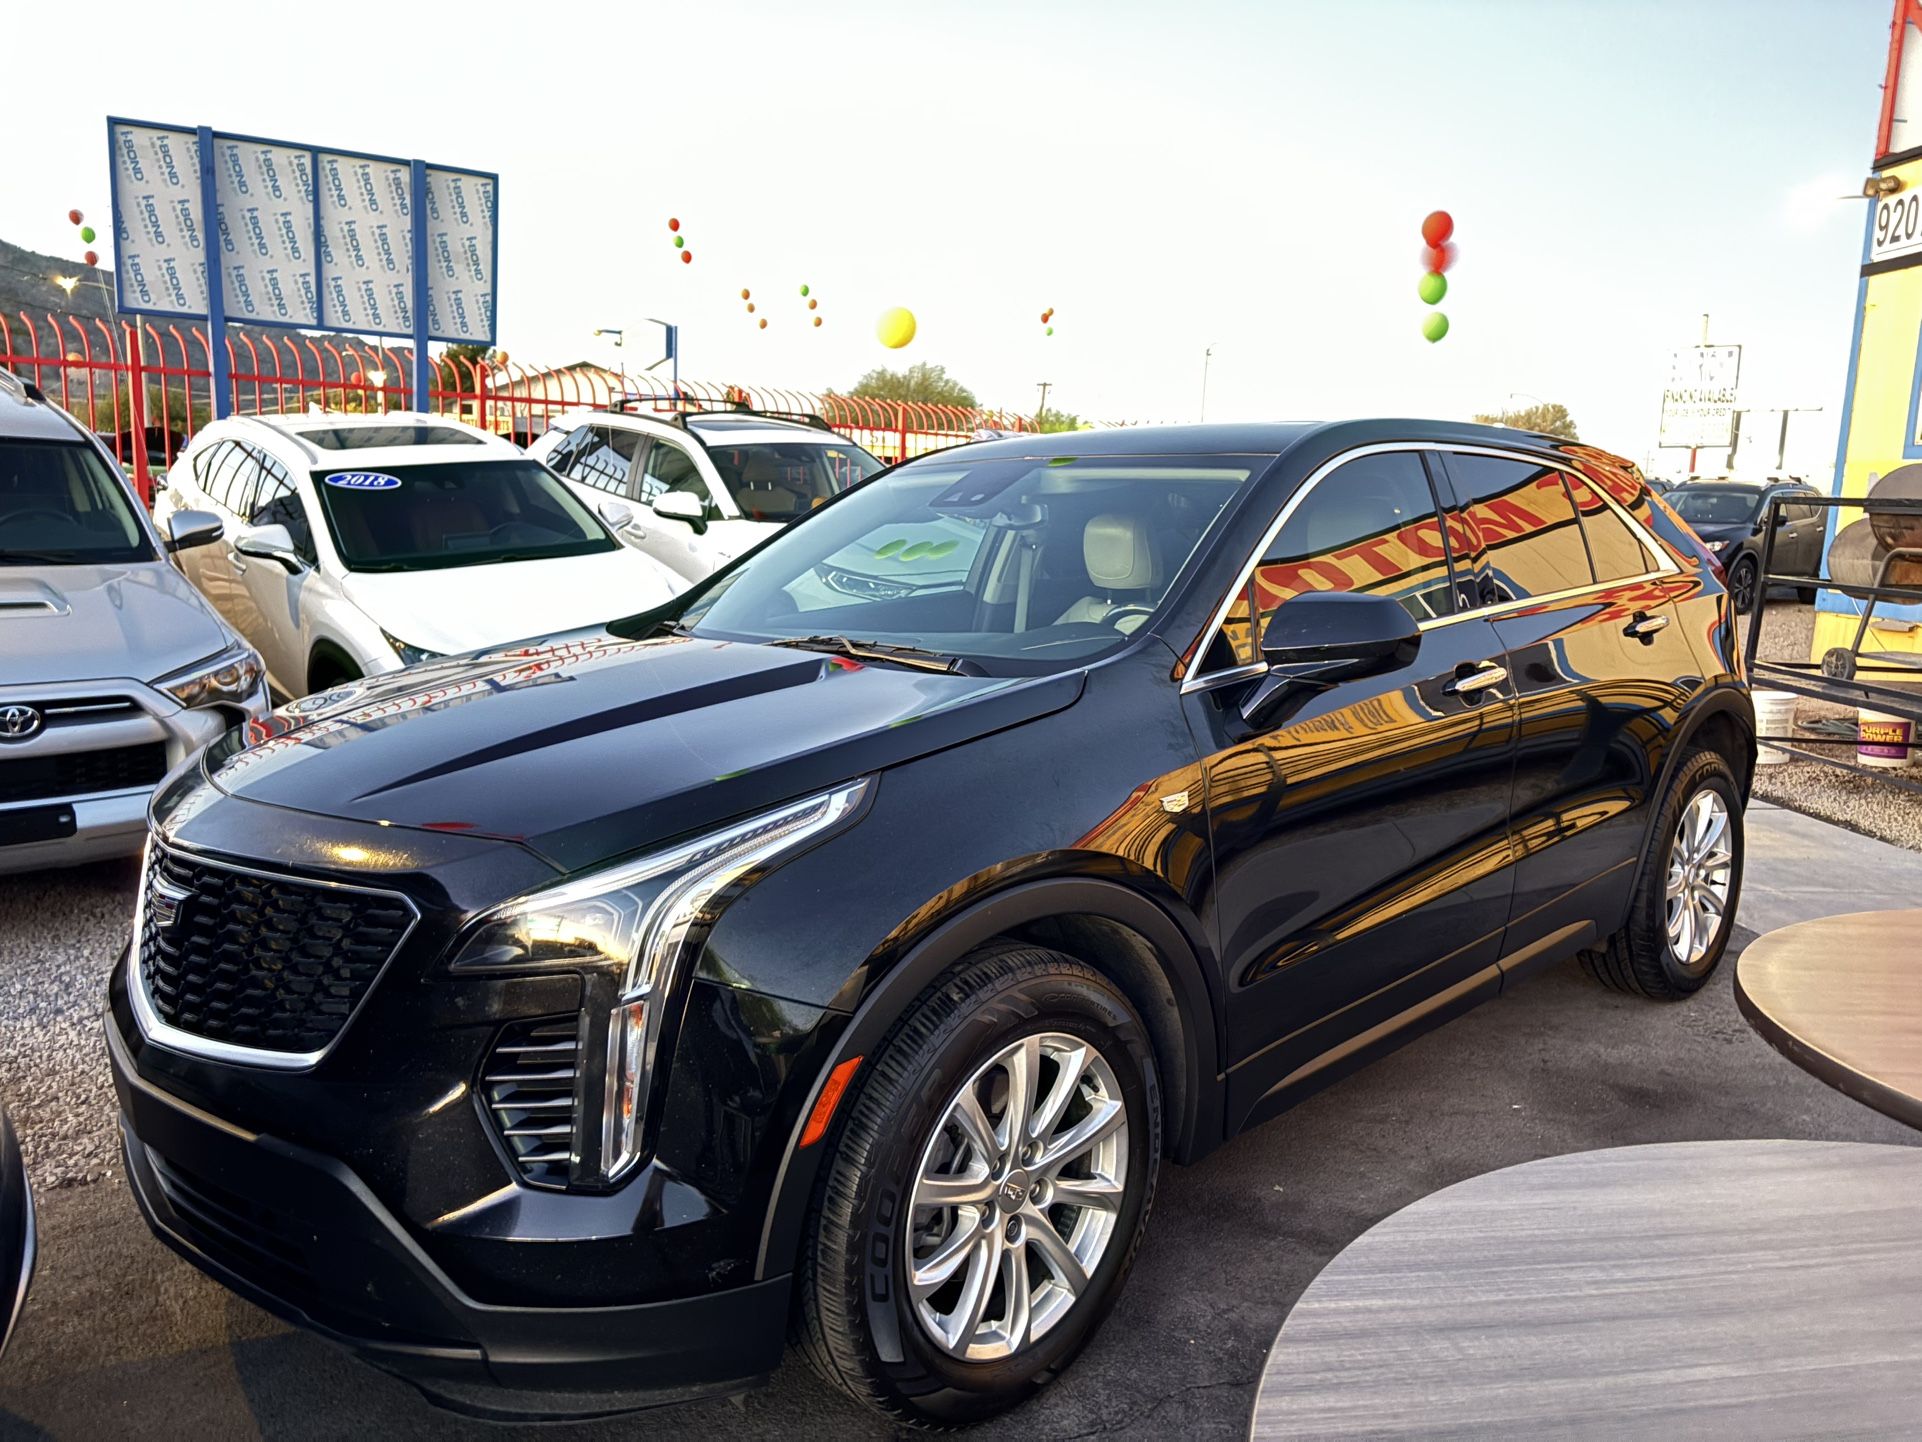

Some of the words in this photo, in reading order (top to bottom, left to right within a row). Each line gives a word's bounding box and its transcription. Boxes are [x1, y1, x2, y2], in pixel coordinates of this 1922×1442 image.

[1877, 194, 1922, 248] 920
[339, 473, 389, 488] 2018
[1860, 724, 1903, 736] PURPLE
[1860, 731, 1903, 743] POWER
